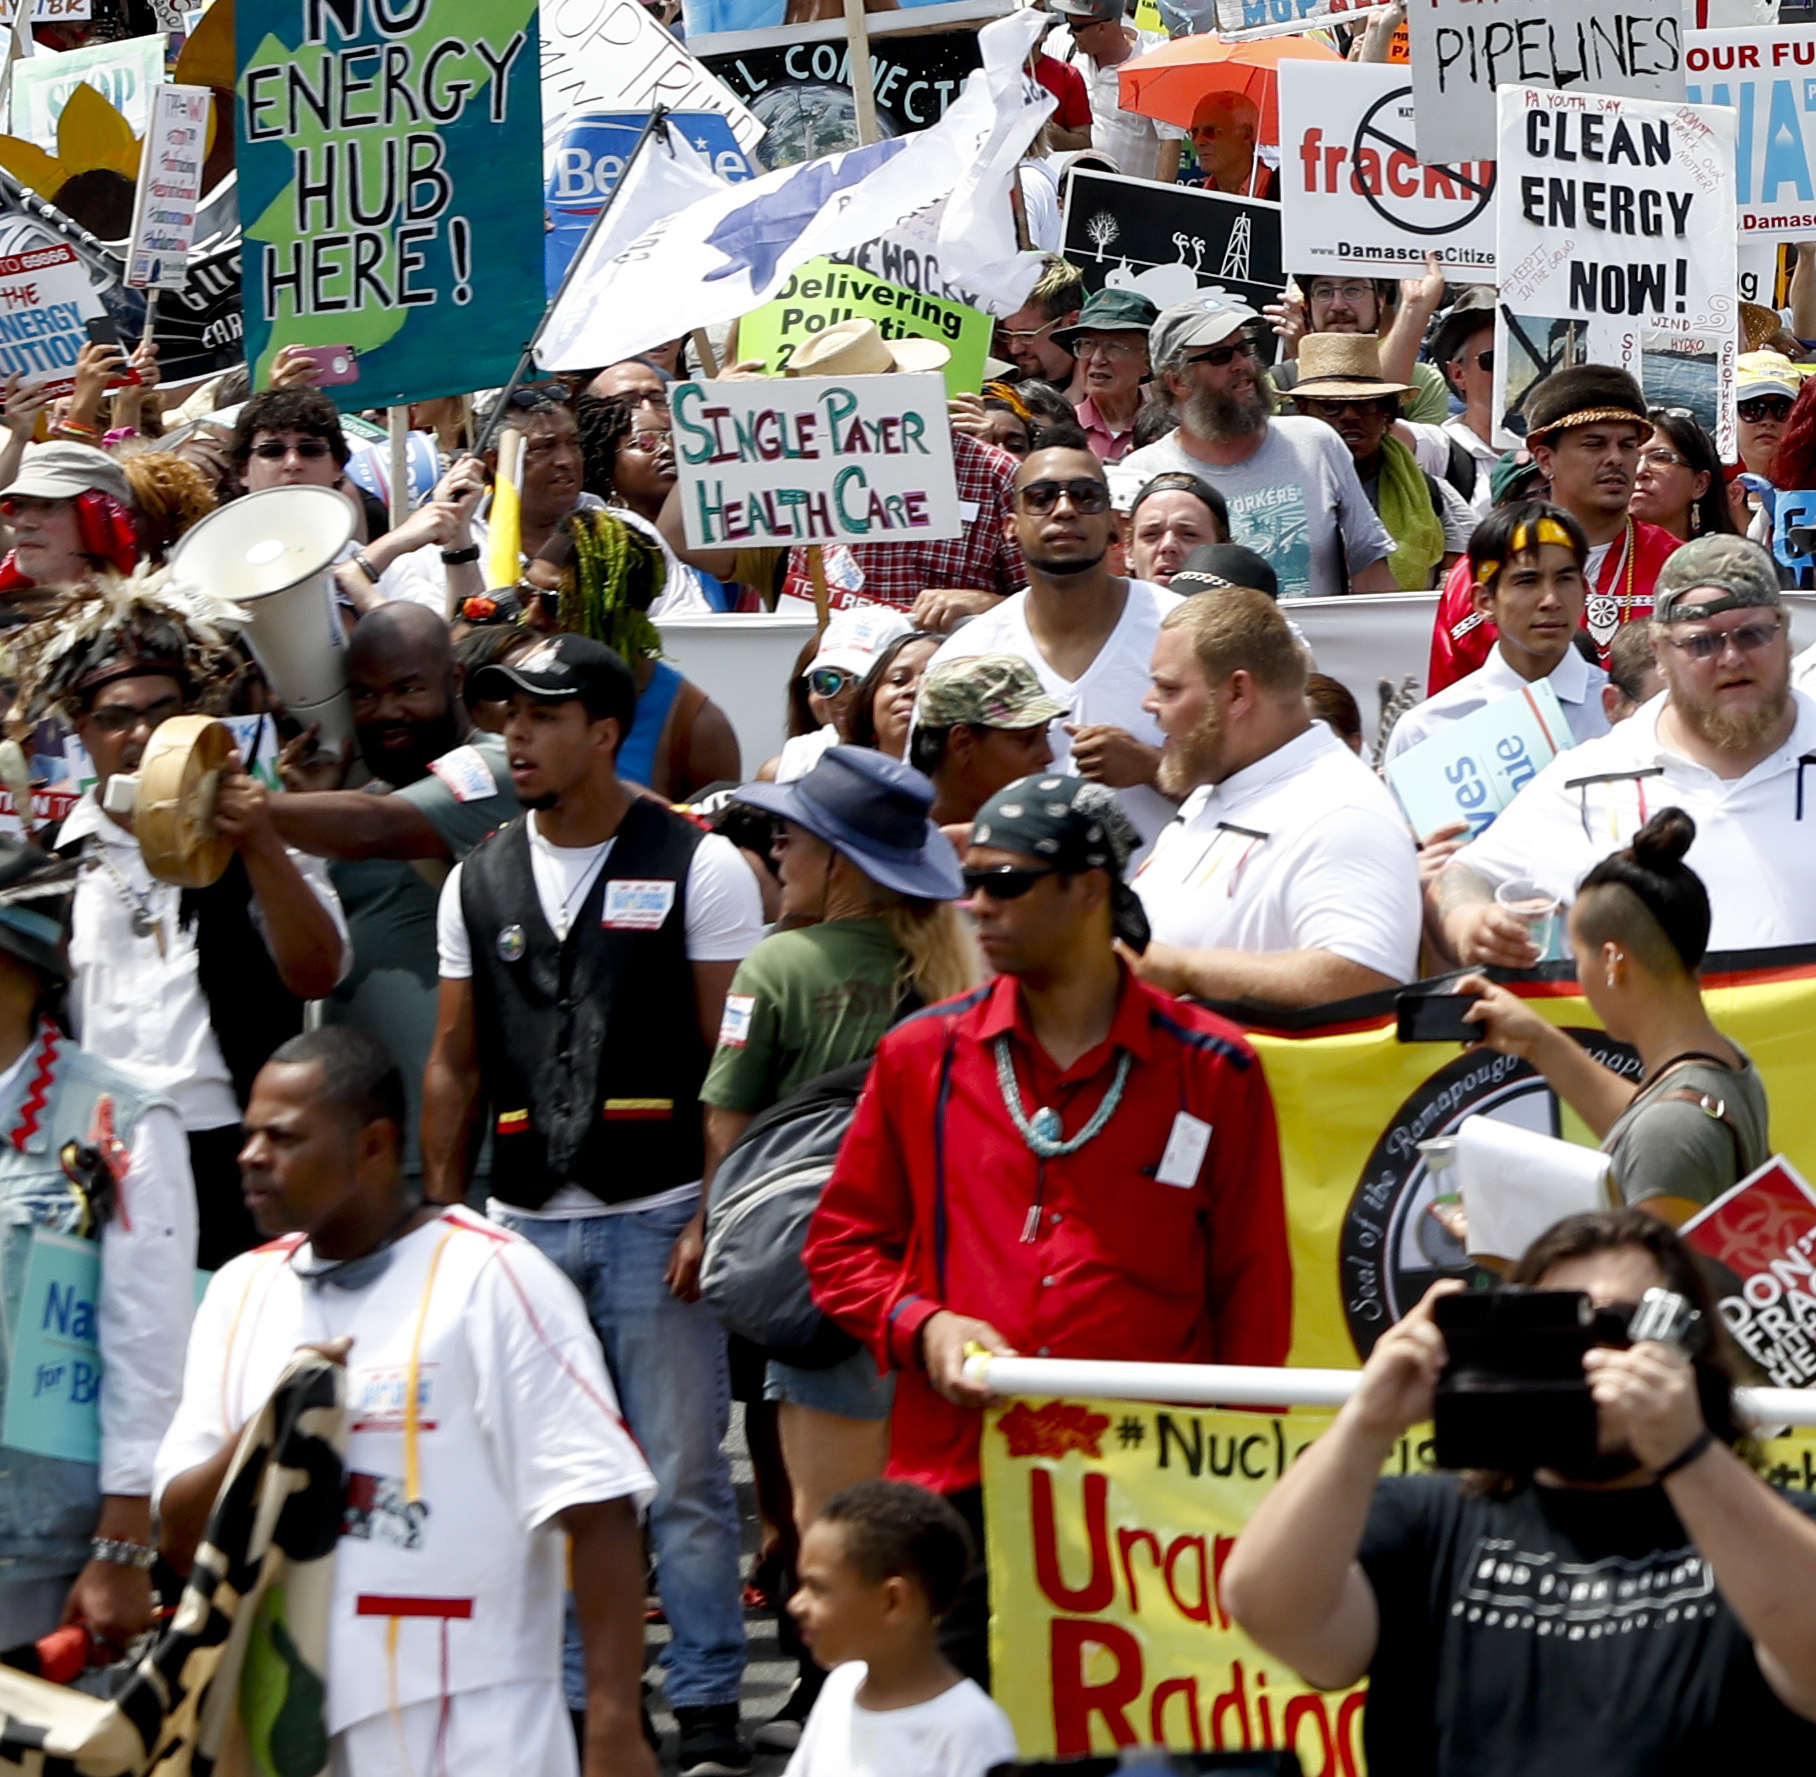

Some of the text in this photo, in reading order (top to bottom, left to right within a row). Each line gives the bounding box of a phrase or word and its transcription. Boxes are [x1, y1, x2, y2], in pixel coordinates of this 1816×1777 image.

[1437, 16, 1679, 94] PIPELINES
[1686, 45, 1760, 71] OUR
[244, 32, 528, 144] ENERGY
[1526, 110, 1671, 166] CLEAN
[295, 132, 453, 238] HUB
[1521, 176, 1694, 238] ENERGY
[262, 214, 475, 320] HERE!
[1570, 259, 1688, 315] NOW!
[1671, 338, 1705, 352] HYDRO
